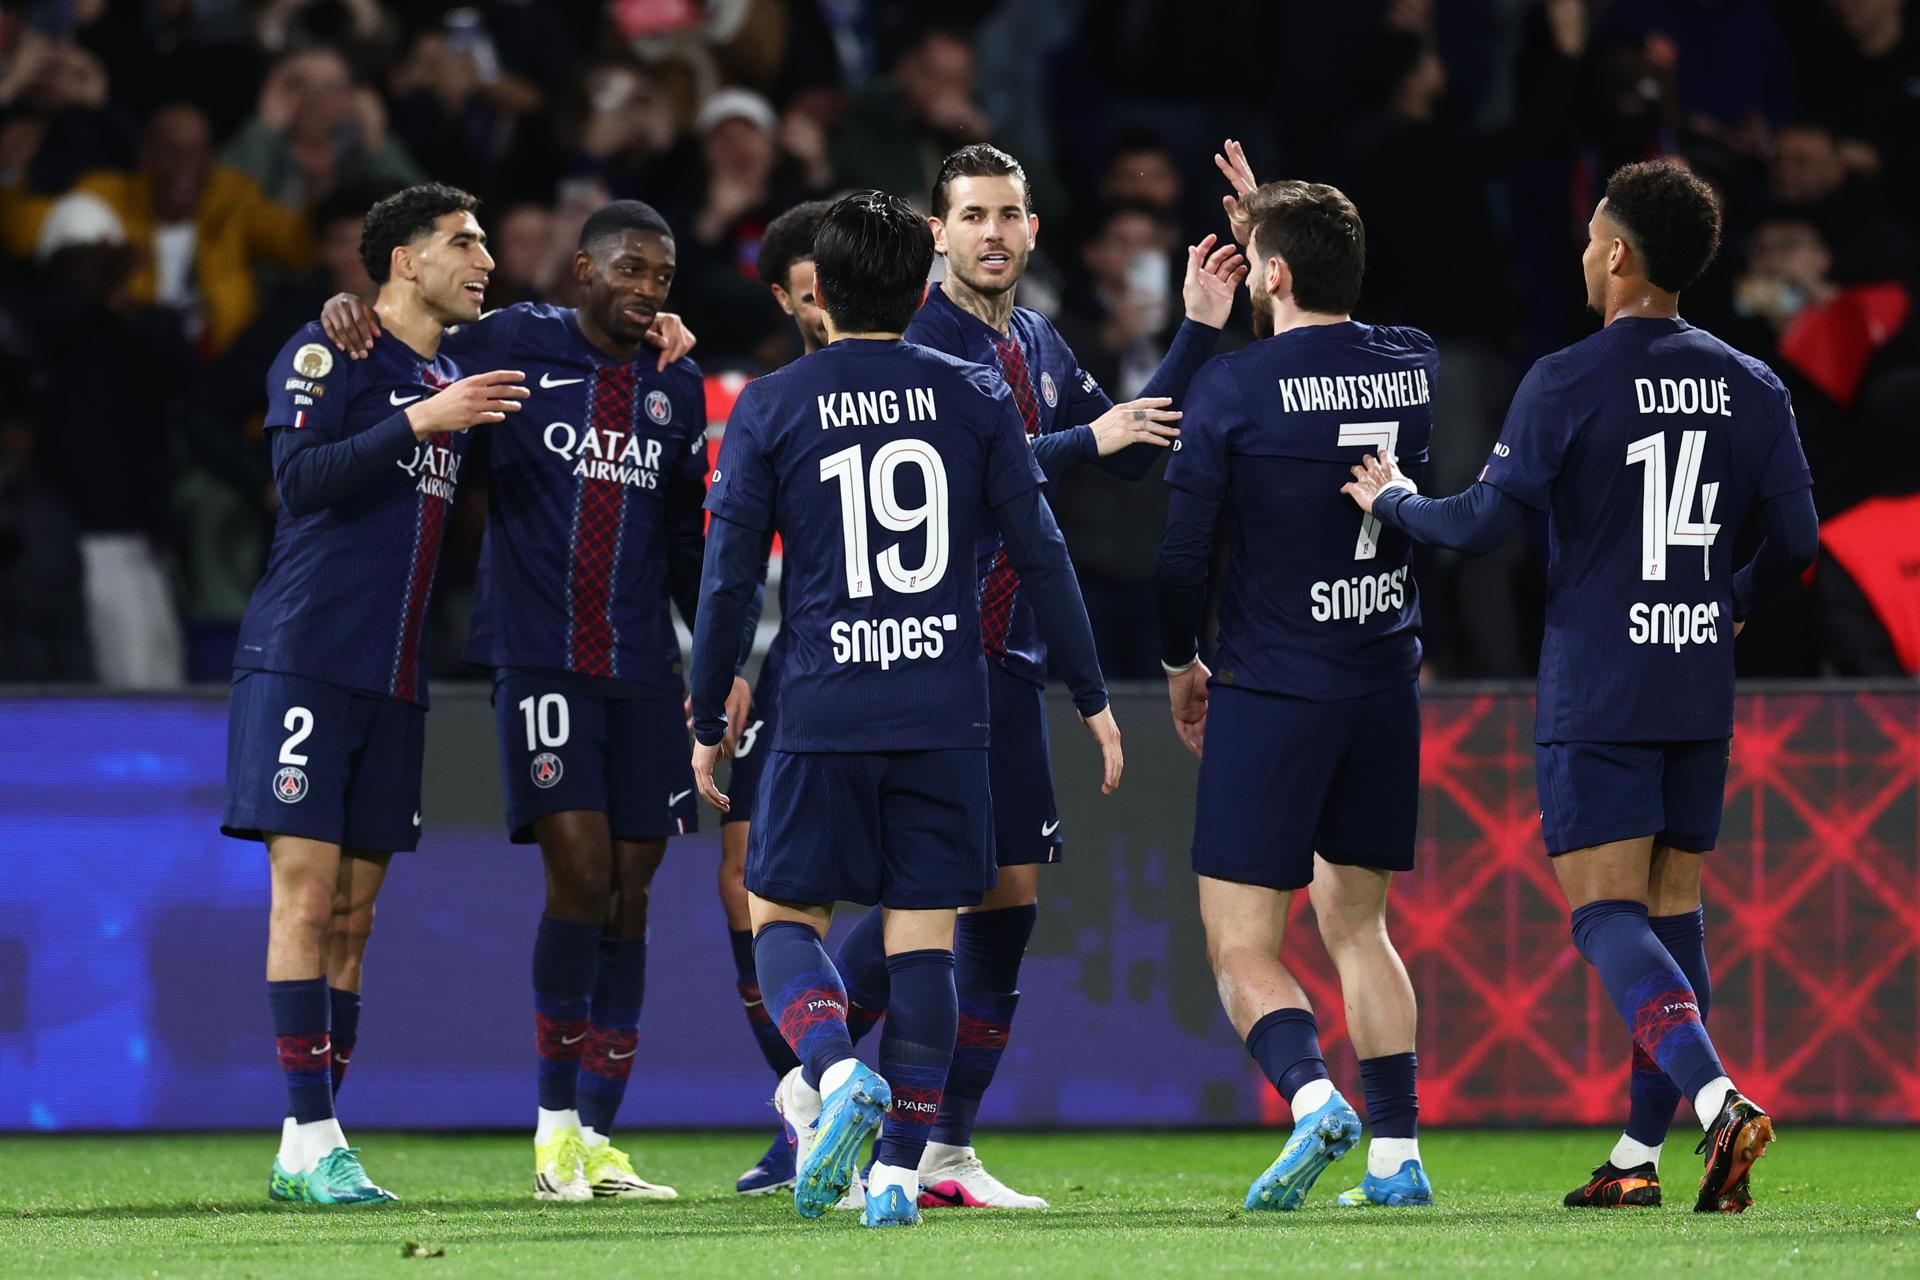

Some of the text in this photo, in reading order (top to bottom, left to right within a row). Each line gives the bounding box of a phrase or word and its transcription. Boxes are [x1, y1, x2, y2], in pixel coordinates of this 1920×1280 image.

[818, 388, 937, 429] KANG IN
[1279, 369, 1430, 412] KVARATSKHELIA
[1635, 376, 1732, 417] D.DOUÉ
[543, 422, 662, 471] QATAR
[572, 458, 659, 490] AIRWAYS
[1337, 421, 1399, 560] 7
[1626, 430, 1722, 581] 14
[820, 438, 949, 599] 19
[1311, 569, 1404, 624] snipes
[830, 616, 945, 671] snipes
[278, 706, 314, 766] 2
[519, 693, 570, 751] 10
[897, 1099, 937, 1113] PARIS
